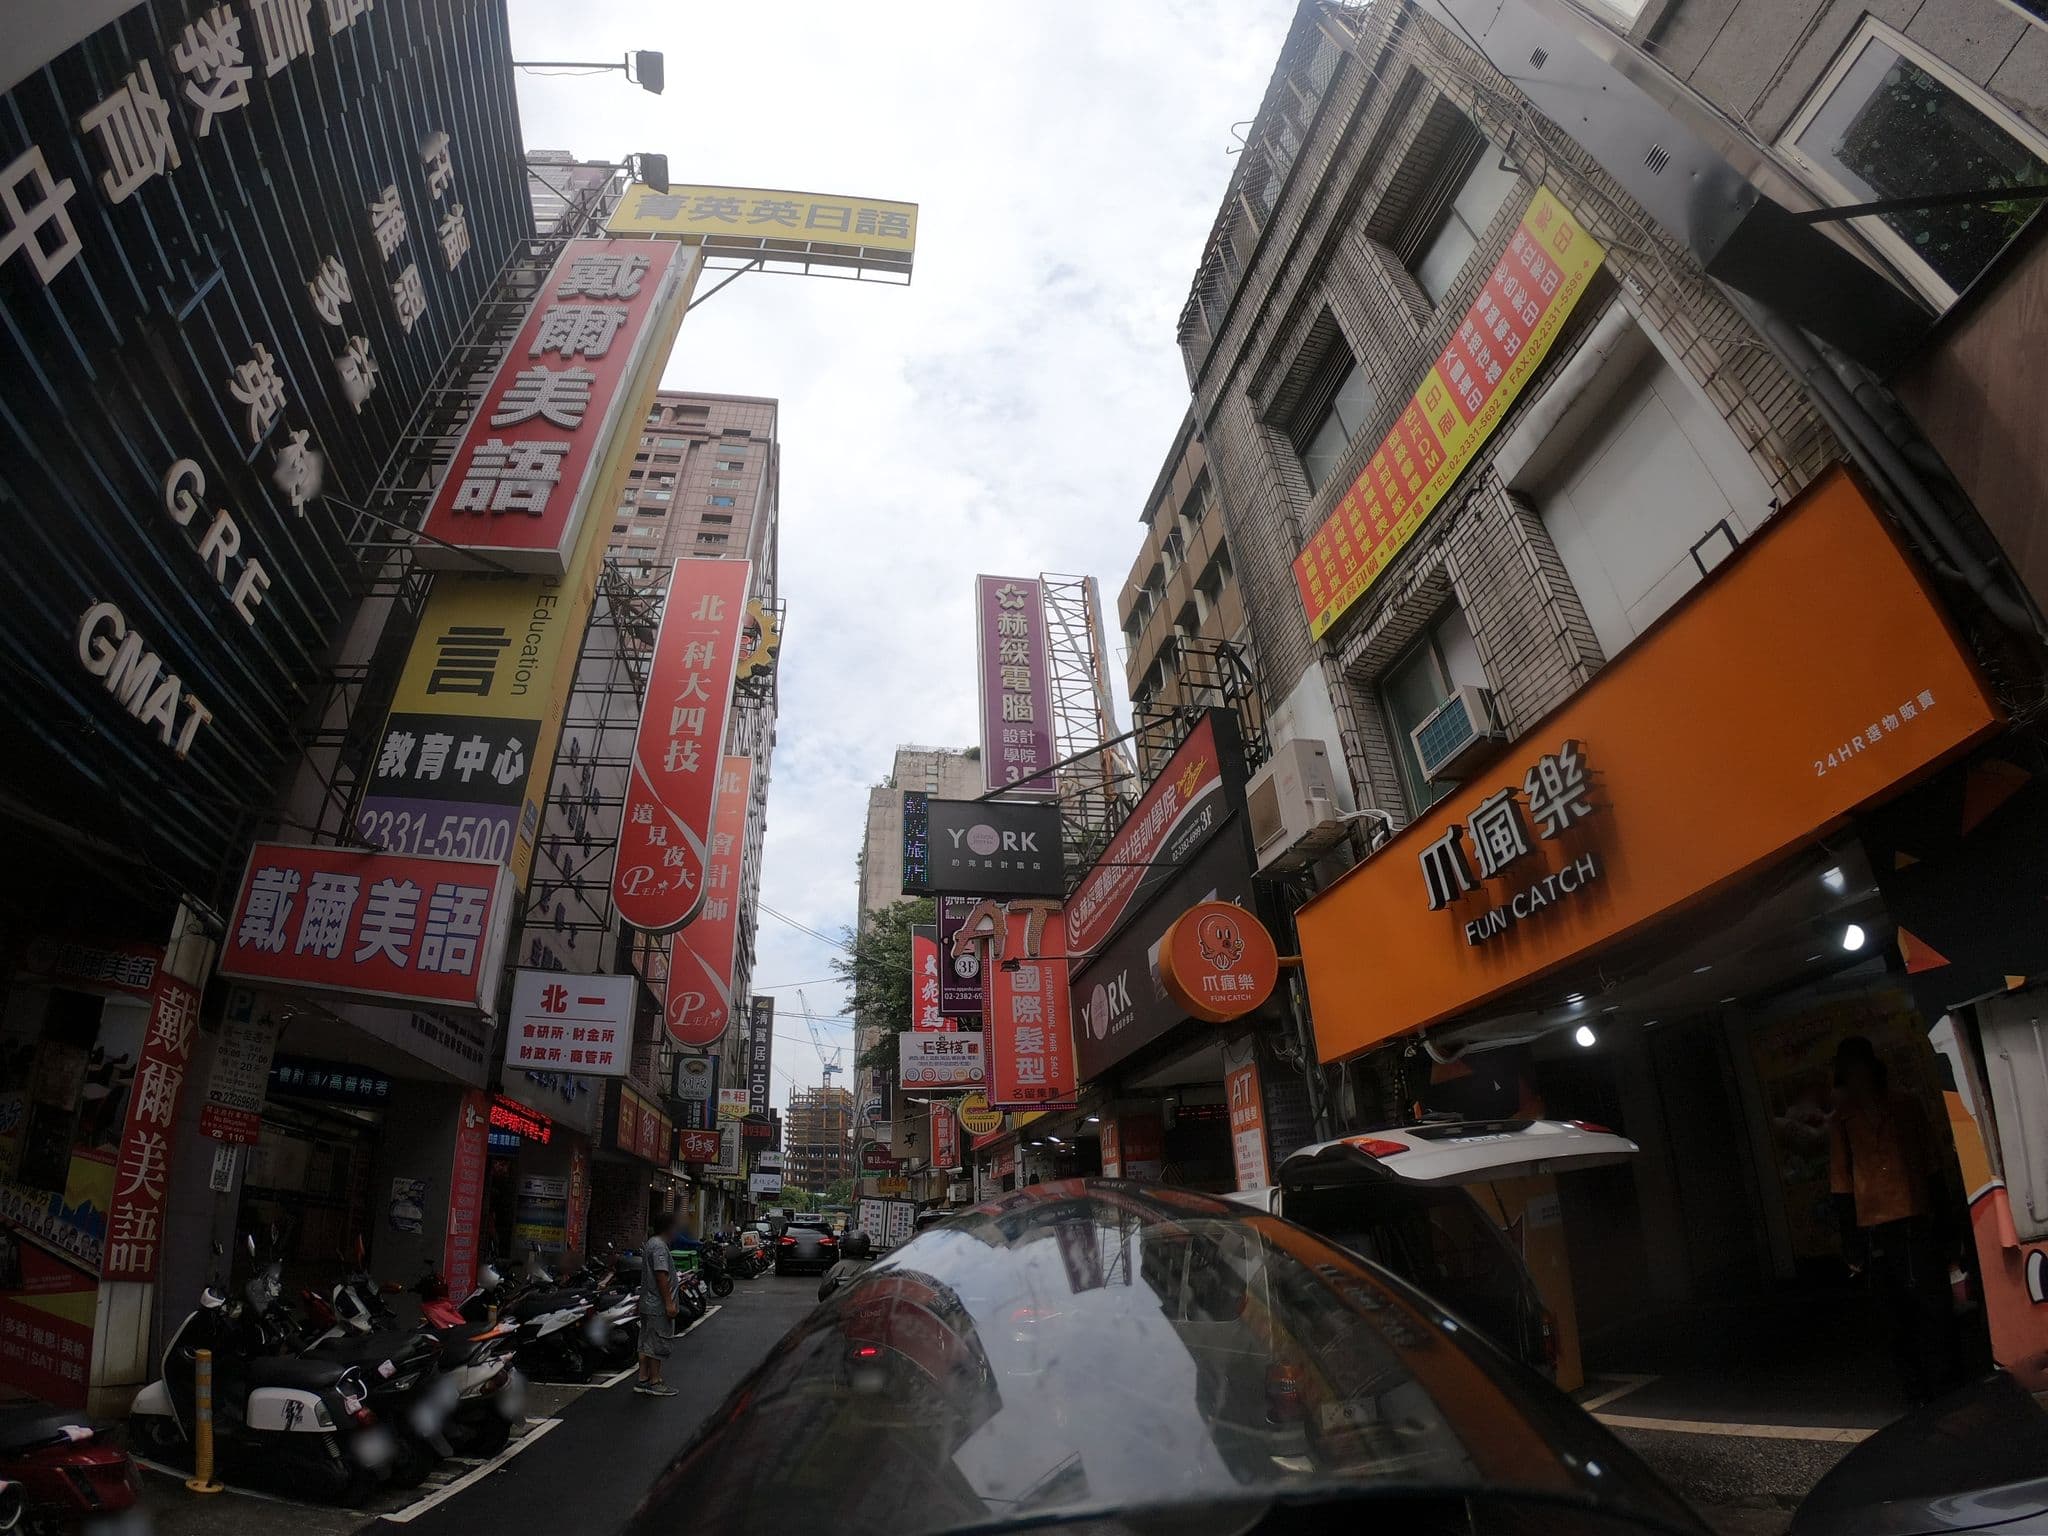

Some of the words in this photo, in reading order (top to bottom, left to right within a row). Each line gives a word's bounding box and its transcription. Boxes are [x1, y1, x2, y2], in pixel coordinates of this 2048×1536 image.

[634, 194, 911, 240] 菁英英日語
[1534, 203, 1574, 254] 影印
[368, 184, 427, 334] 雅思
[1494, 261, 1539, 328] 彩色影印
[451, 255, 651, 516] 戴爾美語
[1425, 384, 1456, 438] 印刷
[1404, 407, 1439, 473] 名片DM
[163, 458, 273, 627] GRE
[511, 595, 559, 696] Education
[76, 601, 213, 762] GMAT
[664, 594, 725, 774] 北一科大四技
[378, 731, 525, 785] 教育中心
[1002, 730, 1035, 745] 設計
[1004, 748, 1037, 764] 學院
[362, 811, 511, 862] 2331-5500
[631, 803, 696, 890] 遠見夜大
[703, 772, 741, 922] 北一會計師
[1200, 806, 1214, 832] 3F
[1419, 740, 1592, 911] 爪瘋樂
[237, 866, 489, 976] 戴爾美語
[952, 899, 1065, 961] AT
[1464, 907, 1507, 946] FUN
[1512, 852, 1596, 919] CATCH
[541, 985, 606, 1013] 北一
[958, 961, 975, 973] 3F
[1043, 966, 1056, 1030] INTERNATIONAL
[1203, 973, 1255, 991] 爪瘋樂
[1011, 965, 1046, 1085] 國際髮型
[108, 984, 199, 1273] 戴爾美語
